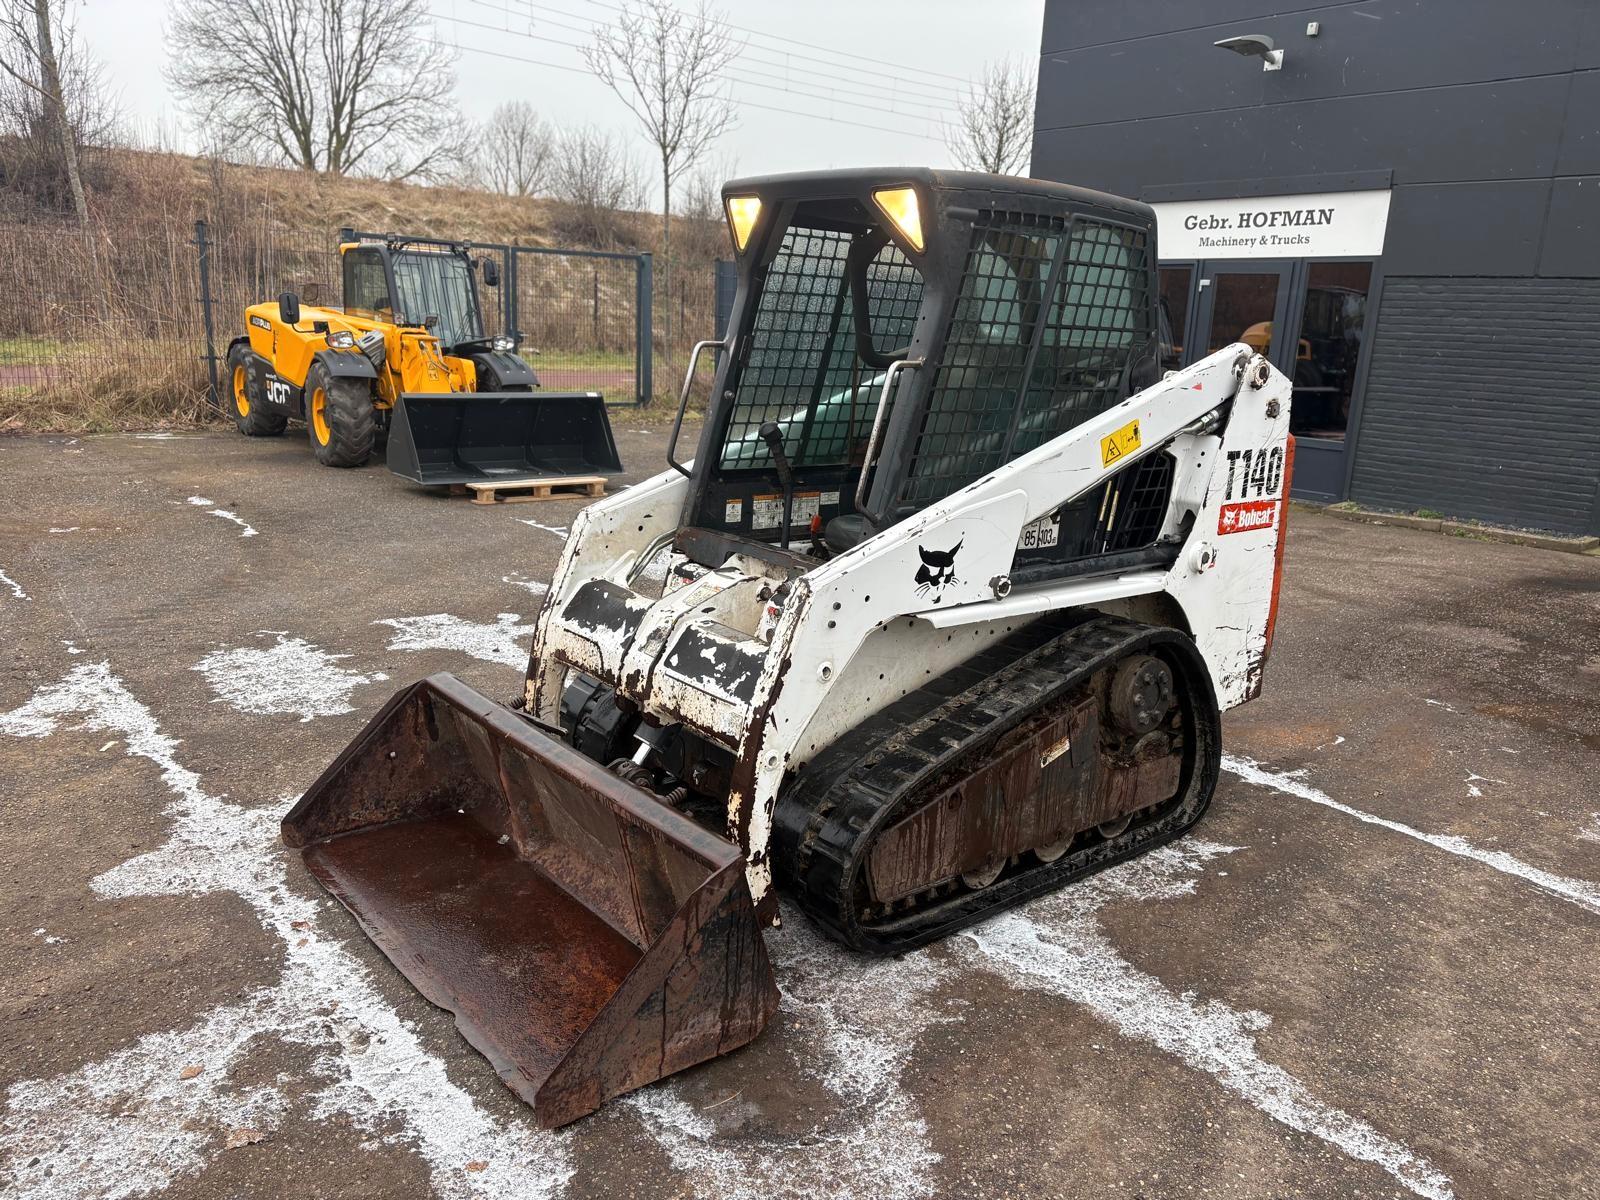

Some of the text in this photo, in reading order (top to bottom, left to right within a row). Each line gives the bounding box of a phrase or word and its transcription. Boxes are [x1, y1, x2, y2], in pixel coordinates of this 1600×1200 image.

[1184, 208, 1335, 231] Gebr. HOFMAN
[1198, 234, 1310, 248] Machinery & Trucks
[1226, 446, 1283, 500] T140
[1238, 507, 1276, 527] Bobcat
[1024, 530, 1036, 546] 85
[1041, 528, 1052, 545] 103
